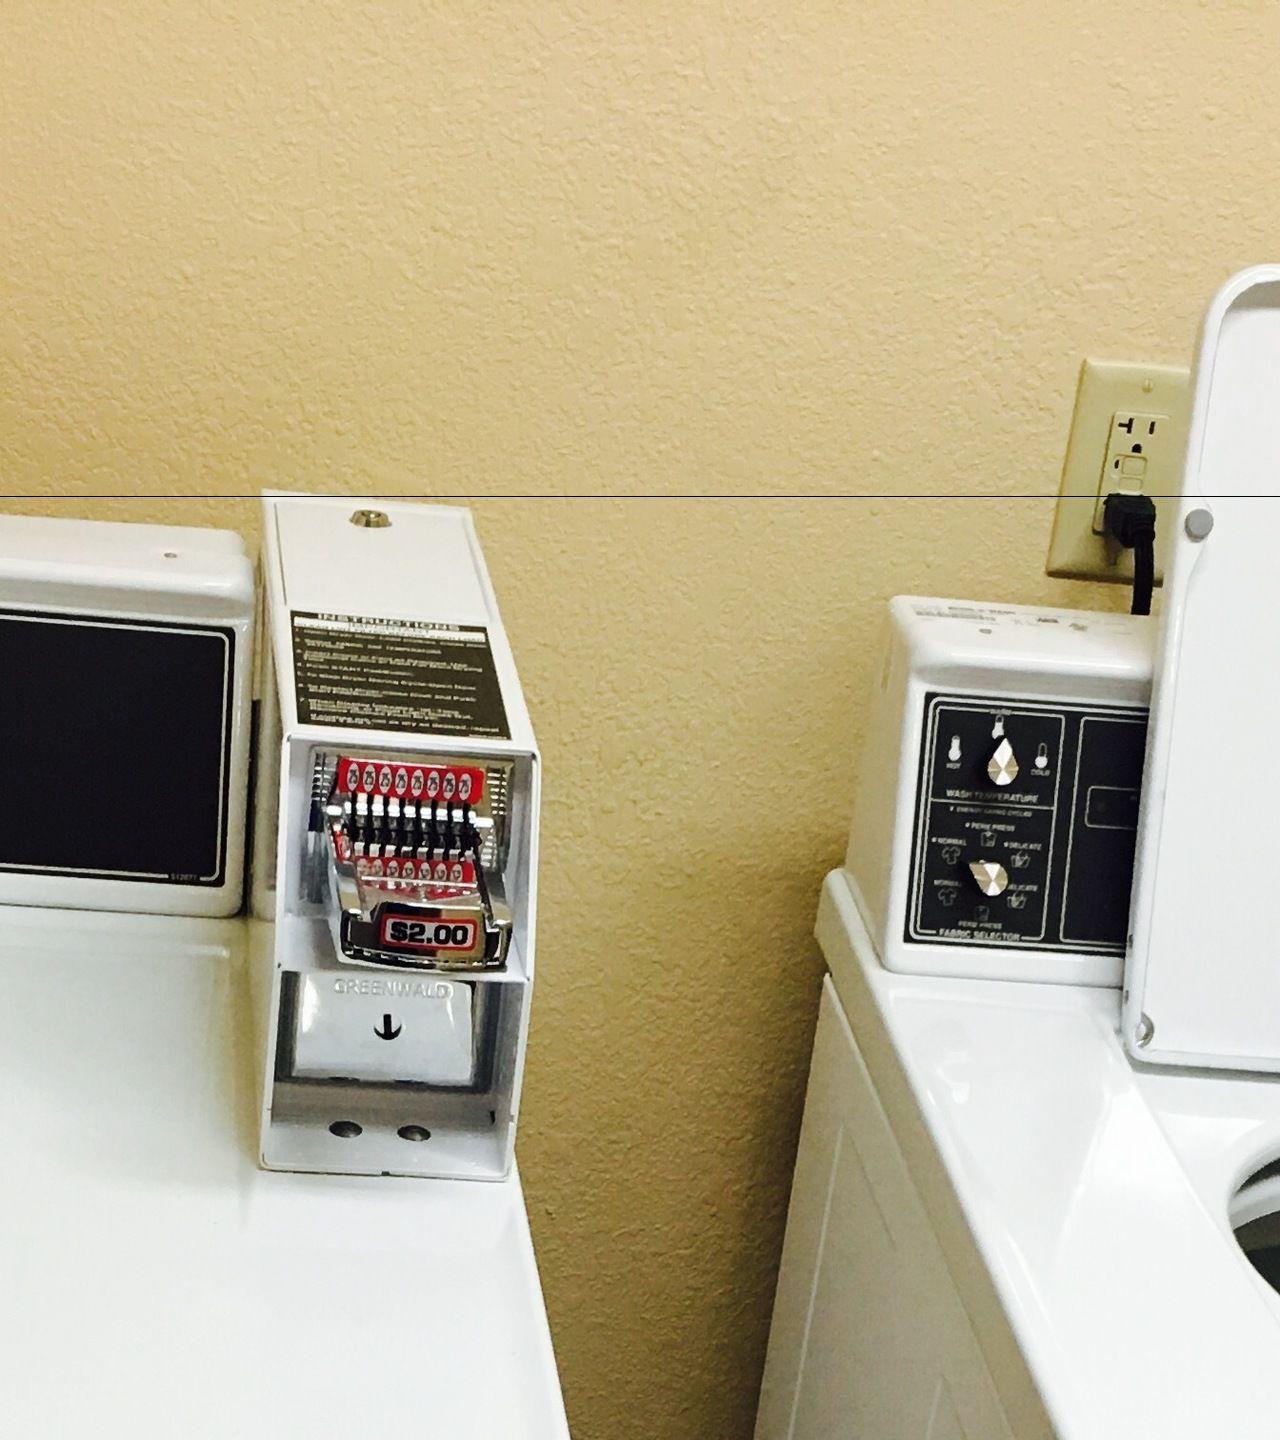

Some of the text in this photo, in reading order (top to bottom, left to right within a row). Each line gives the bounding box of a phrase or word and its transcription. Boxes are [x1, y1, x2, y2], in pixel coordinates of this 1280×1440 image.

[946, 789, 1039, 804] WASH TEMPERATURE
[992, 823, 1015, 832] PRESS
[937, 837, 967, 846] NORMAL
[390, 920, 468, 945] $2.00
[939, 927, 1021, 941] FABRIC SELECTOR
[334, 979, 453, 999] GREENWALD
